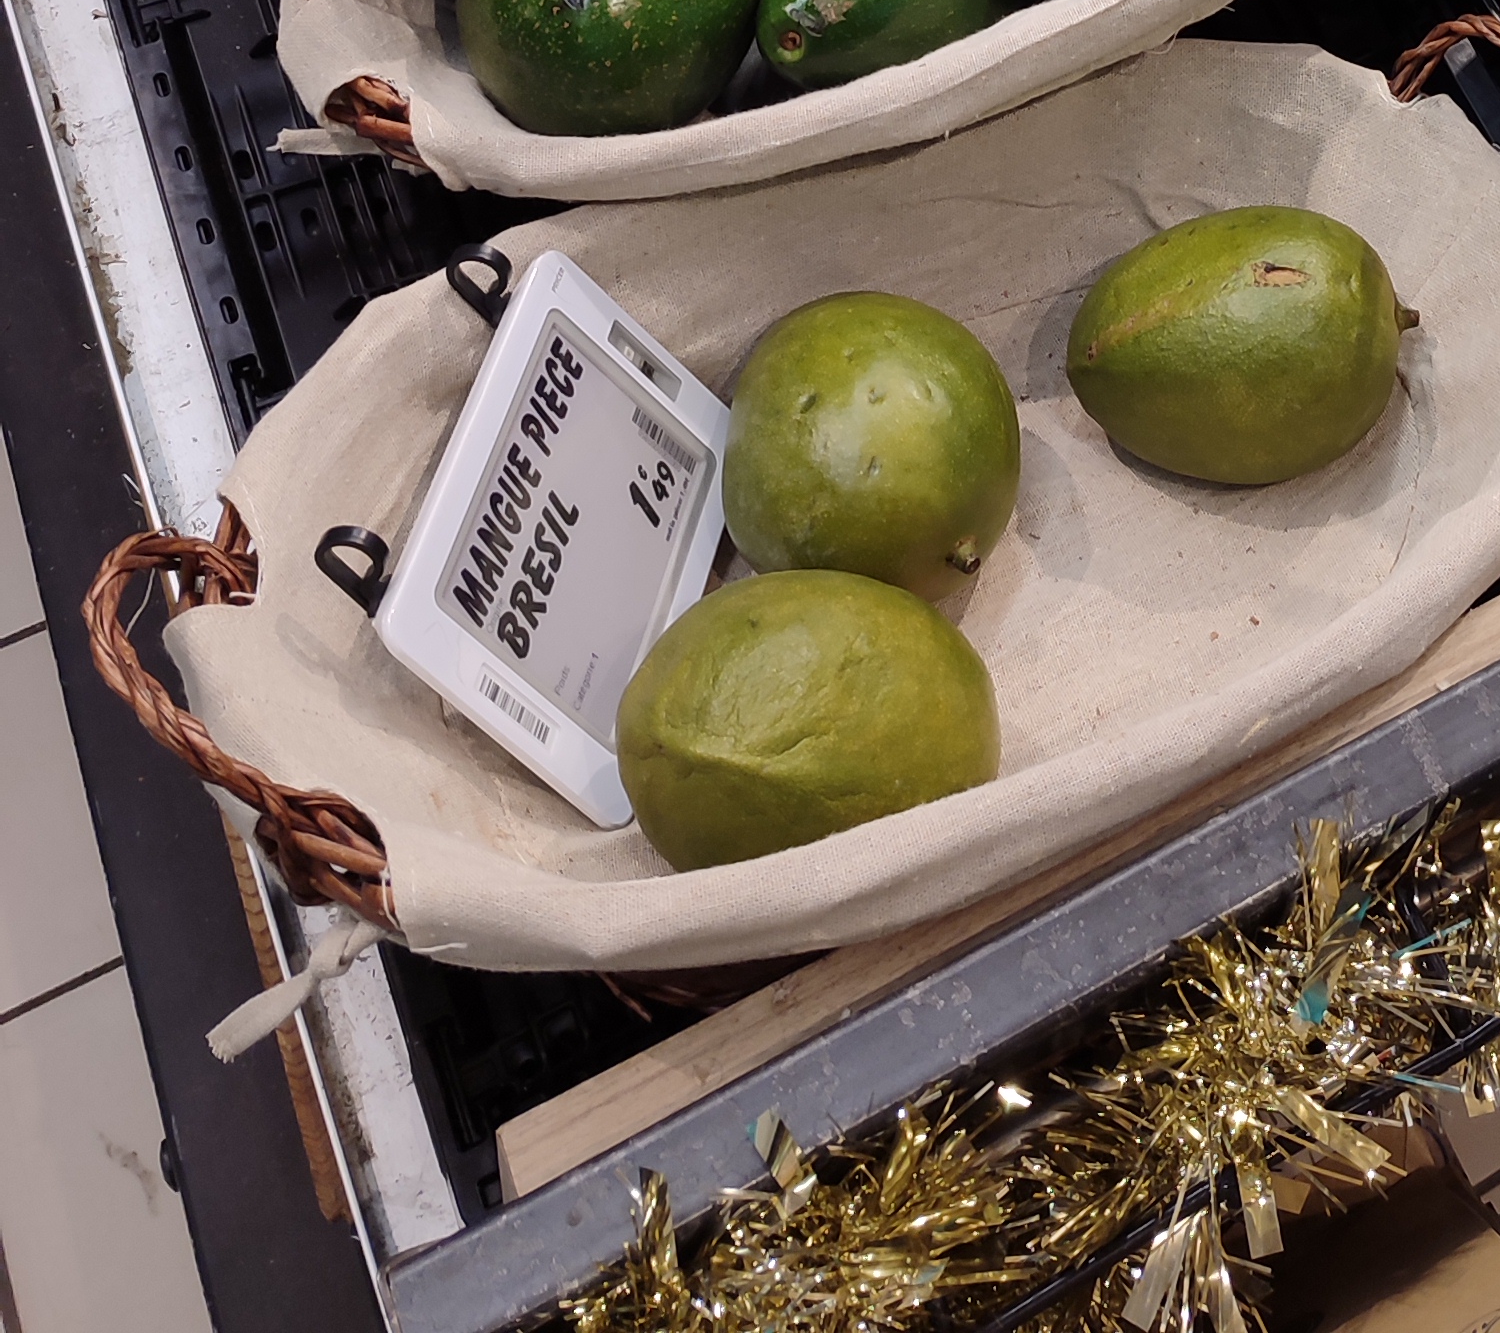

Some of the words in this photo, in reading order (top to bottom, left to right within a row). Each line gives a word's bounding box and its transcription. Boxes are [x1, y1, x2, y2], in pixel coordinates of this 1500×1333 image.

[453, 443, 543, 629] MANGUE
[521, 336, 585, 457] PIECE
[497, 490, 580, 661] BRESIL
